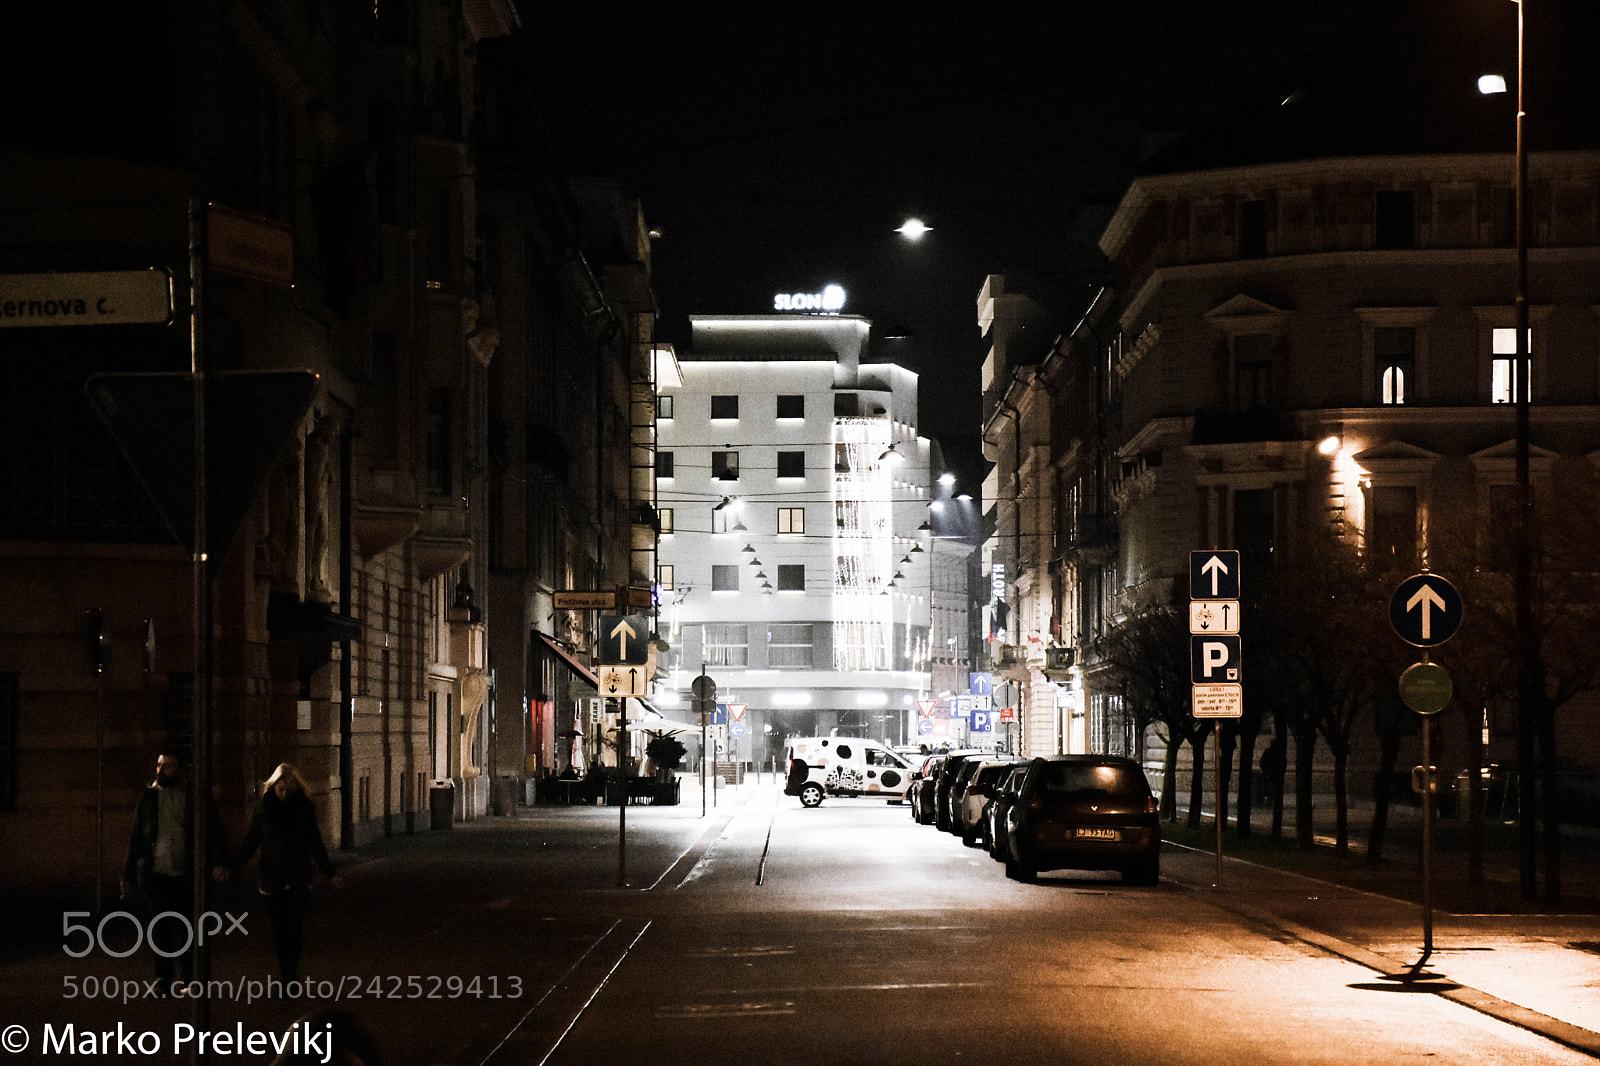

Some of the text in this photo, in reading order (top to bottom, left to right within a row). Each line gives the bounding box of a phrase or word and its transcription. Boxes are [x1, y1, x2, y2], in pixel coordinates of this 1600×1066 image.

[0, 298, 115, 317] ernova c.
[774, 292, 822, 311] SLON
[1203, 642, 1229, 678] P
[975, 712, 987, 730] P
